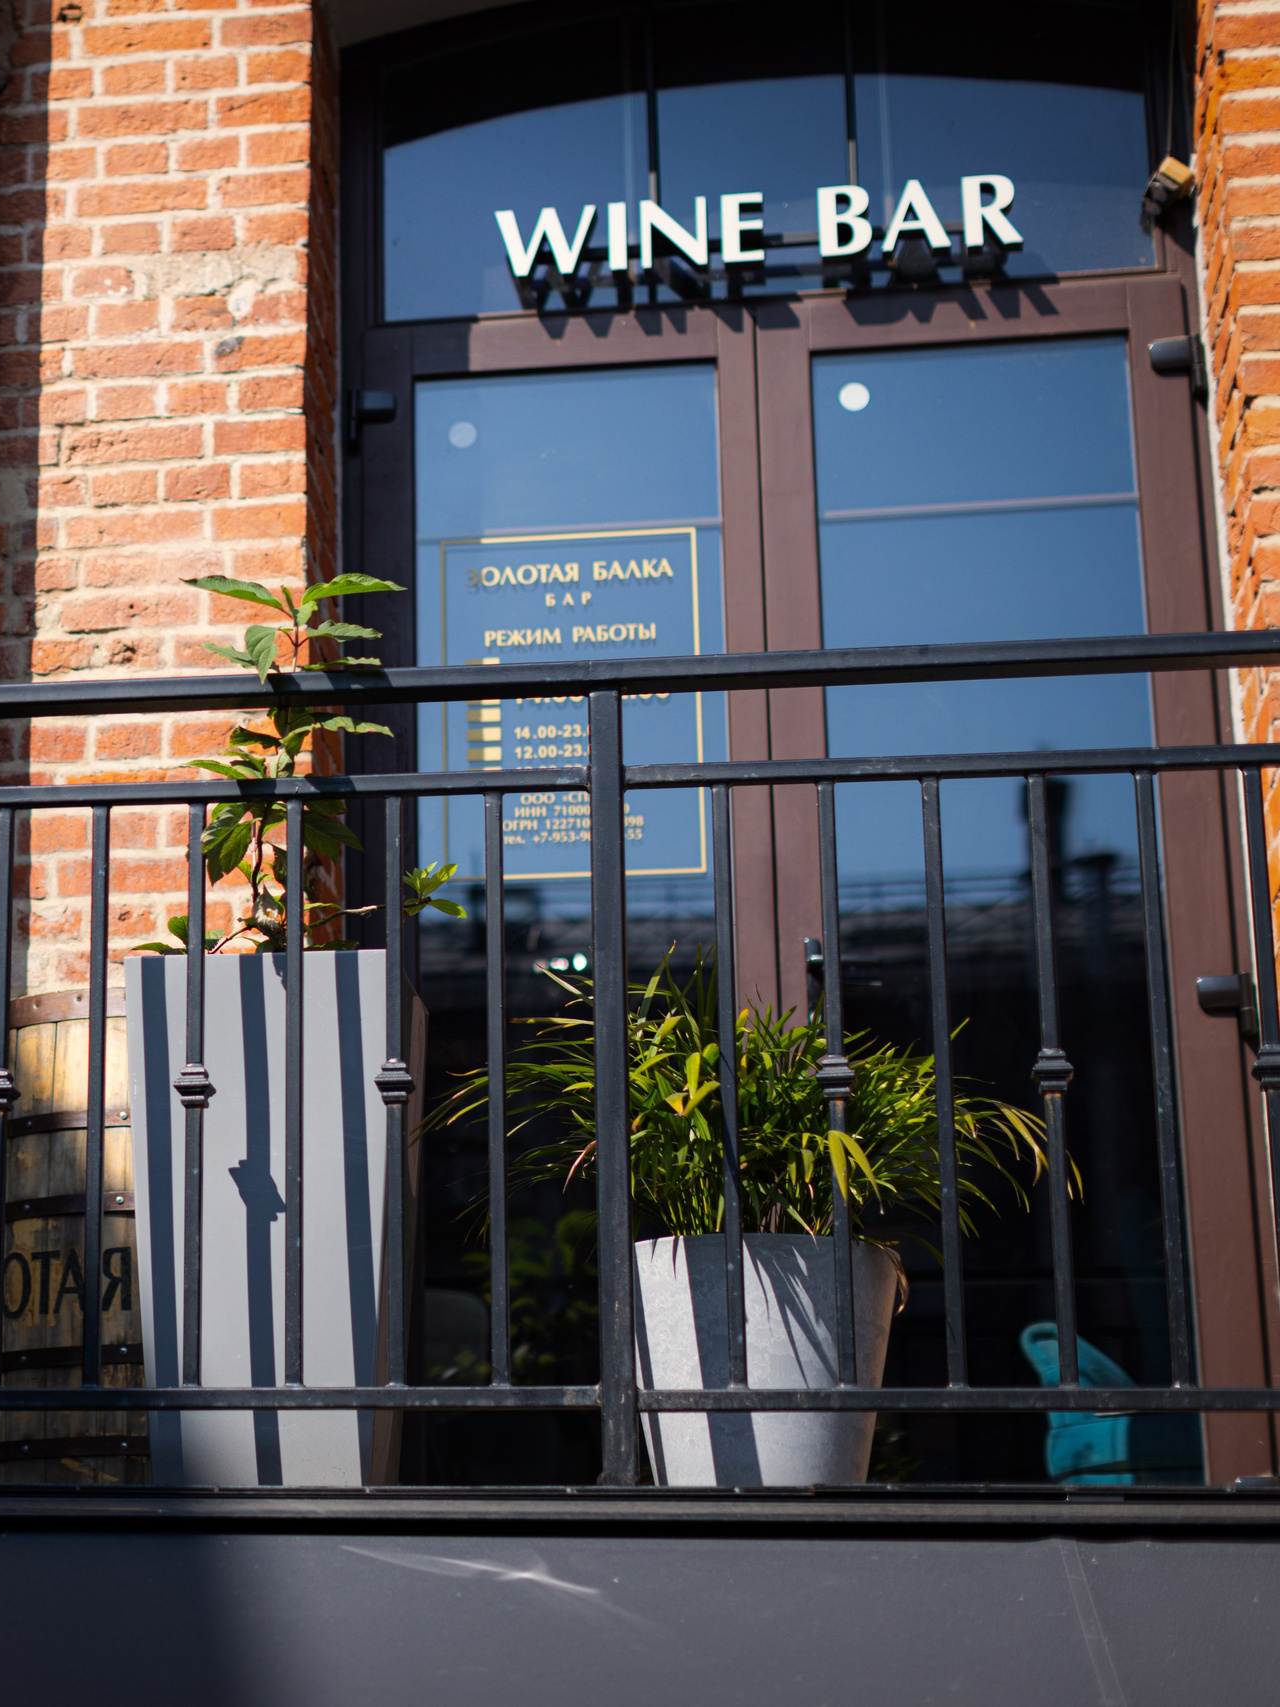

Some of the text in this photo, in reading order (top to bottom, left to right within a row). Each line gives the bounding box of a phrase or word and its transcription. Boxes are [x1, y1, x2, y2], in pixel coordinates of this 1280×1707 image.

[494, 173, 1024, 277] WINE BAR
[592, 557, 674, 581] БАЛКА
[484, 622, 657, 648] РЕЖИМ РАБОТЫ
[514, 724, 591, 739] 14.00-23.
[514, 744, 591, 759] 12.00-23.
[520, 792, 556, 806] ООО
[514, 803, 631, 818] ИНН 710000
[502, 818, 538, 832] ОГРН
